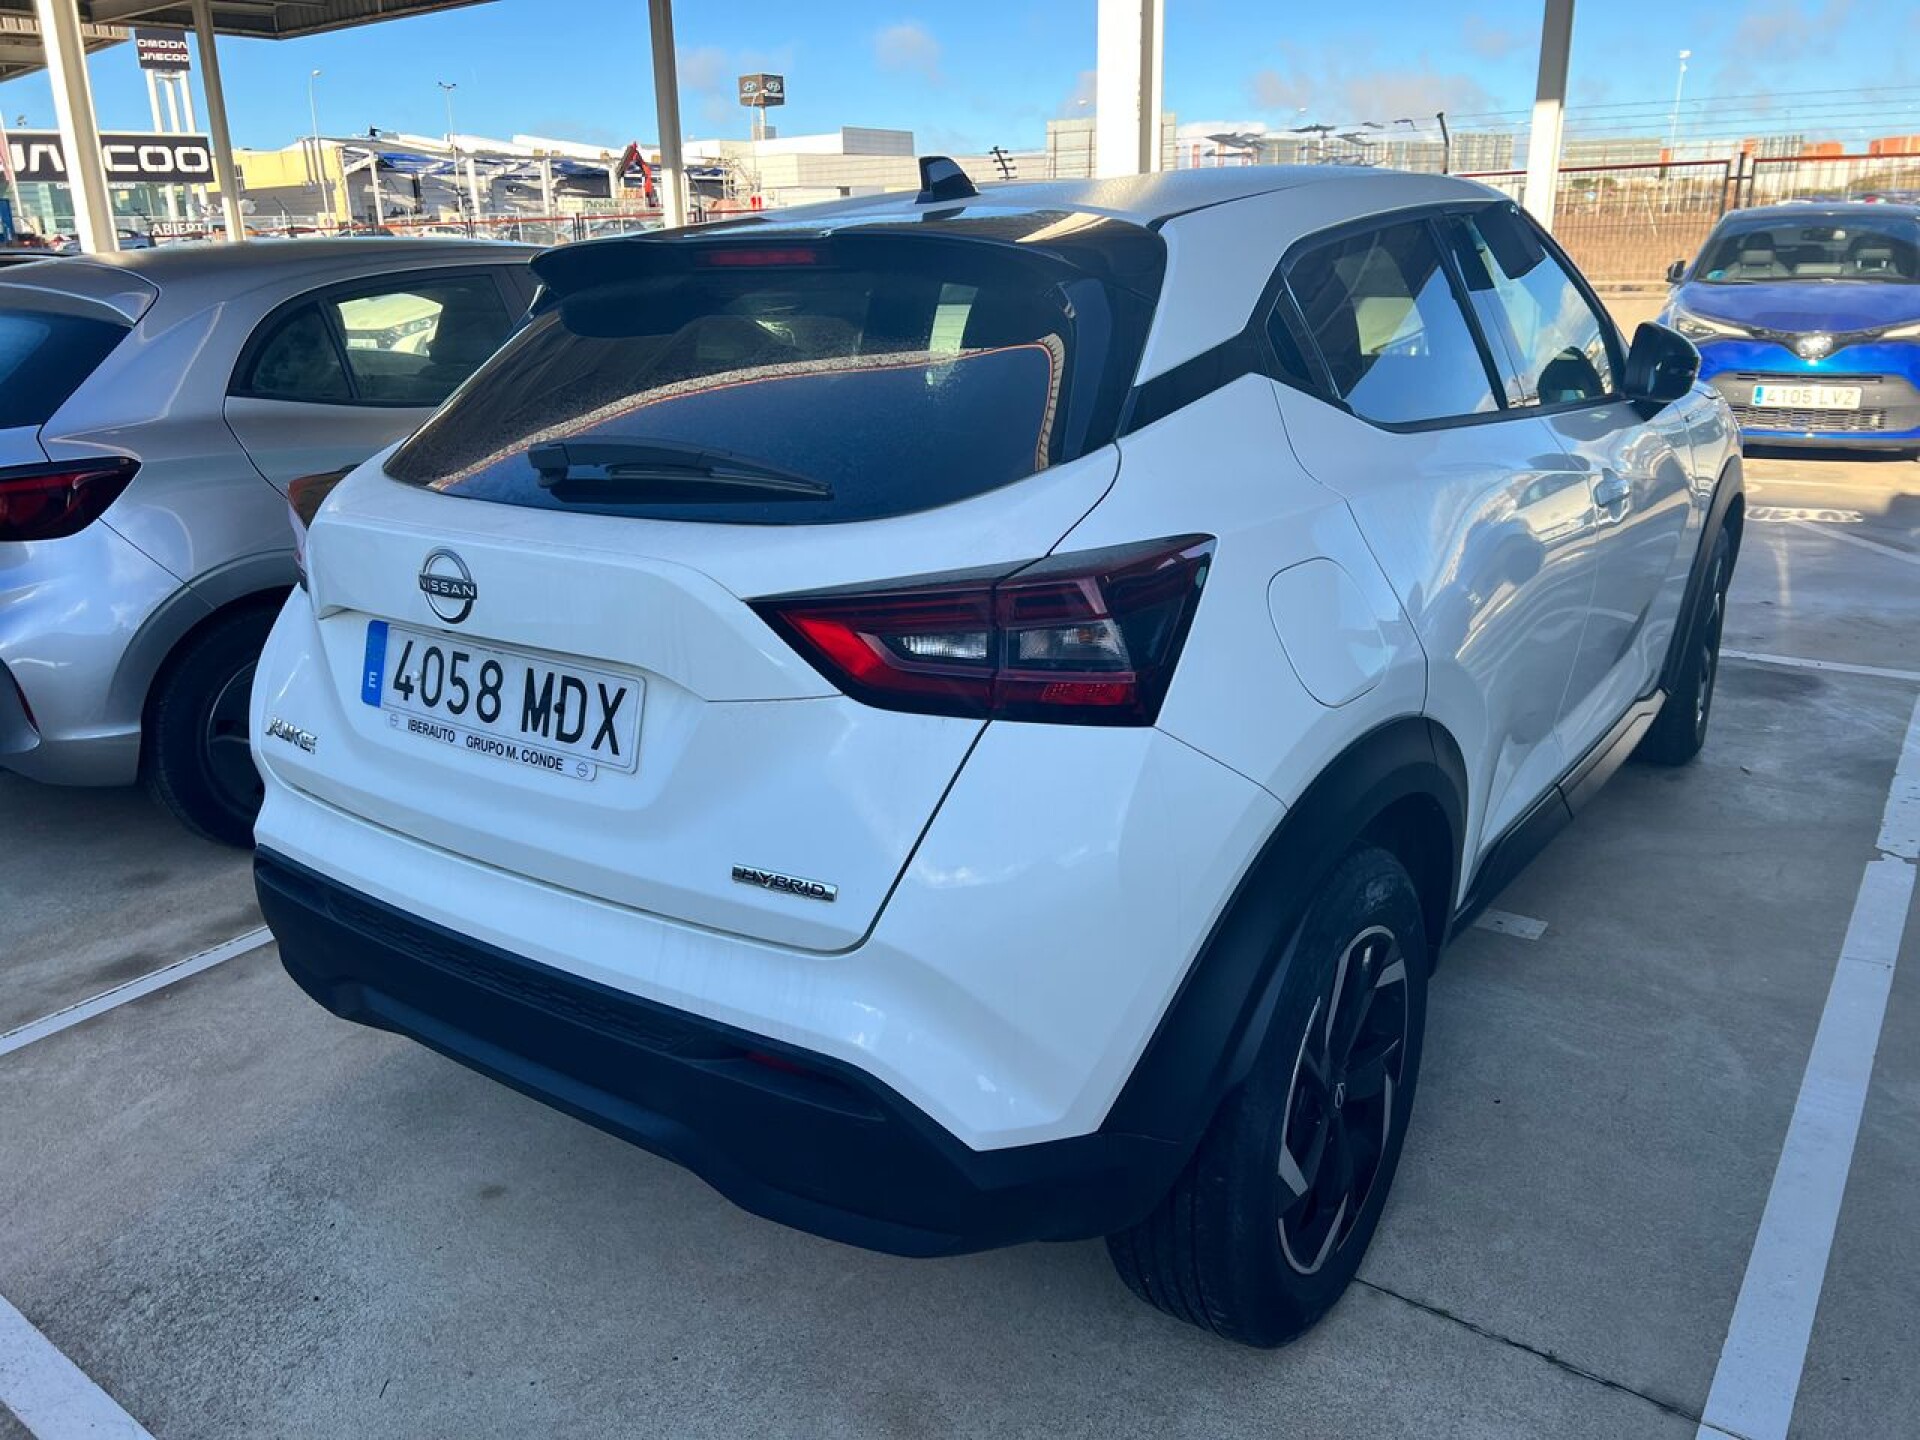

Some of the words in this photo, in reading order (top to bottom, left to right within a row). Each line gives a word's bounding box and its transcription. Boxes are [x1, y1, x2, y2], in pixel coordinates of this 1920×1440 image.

[138, 39, 187, 49] OMODA
[140, 52, 189, 62] JAECOO
[419, 576, 475, 597] NISSAN
[368, 671, 378, 688] E
[392, 640, 504, 724] 4058
[520, 667, 627, 756] MDX
[265, 716, 317, 755] JUKE
[407, 719, 456, 743] IBERAUTO
[466, 734, 504, 757] GRUPO
[505, 745, 519, 761] M.
[521, 748, 563, 772] CONDE
[742, 867, 826, 896] HYBRID
